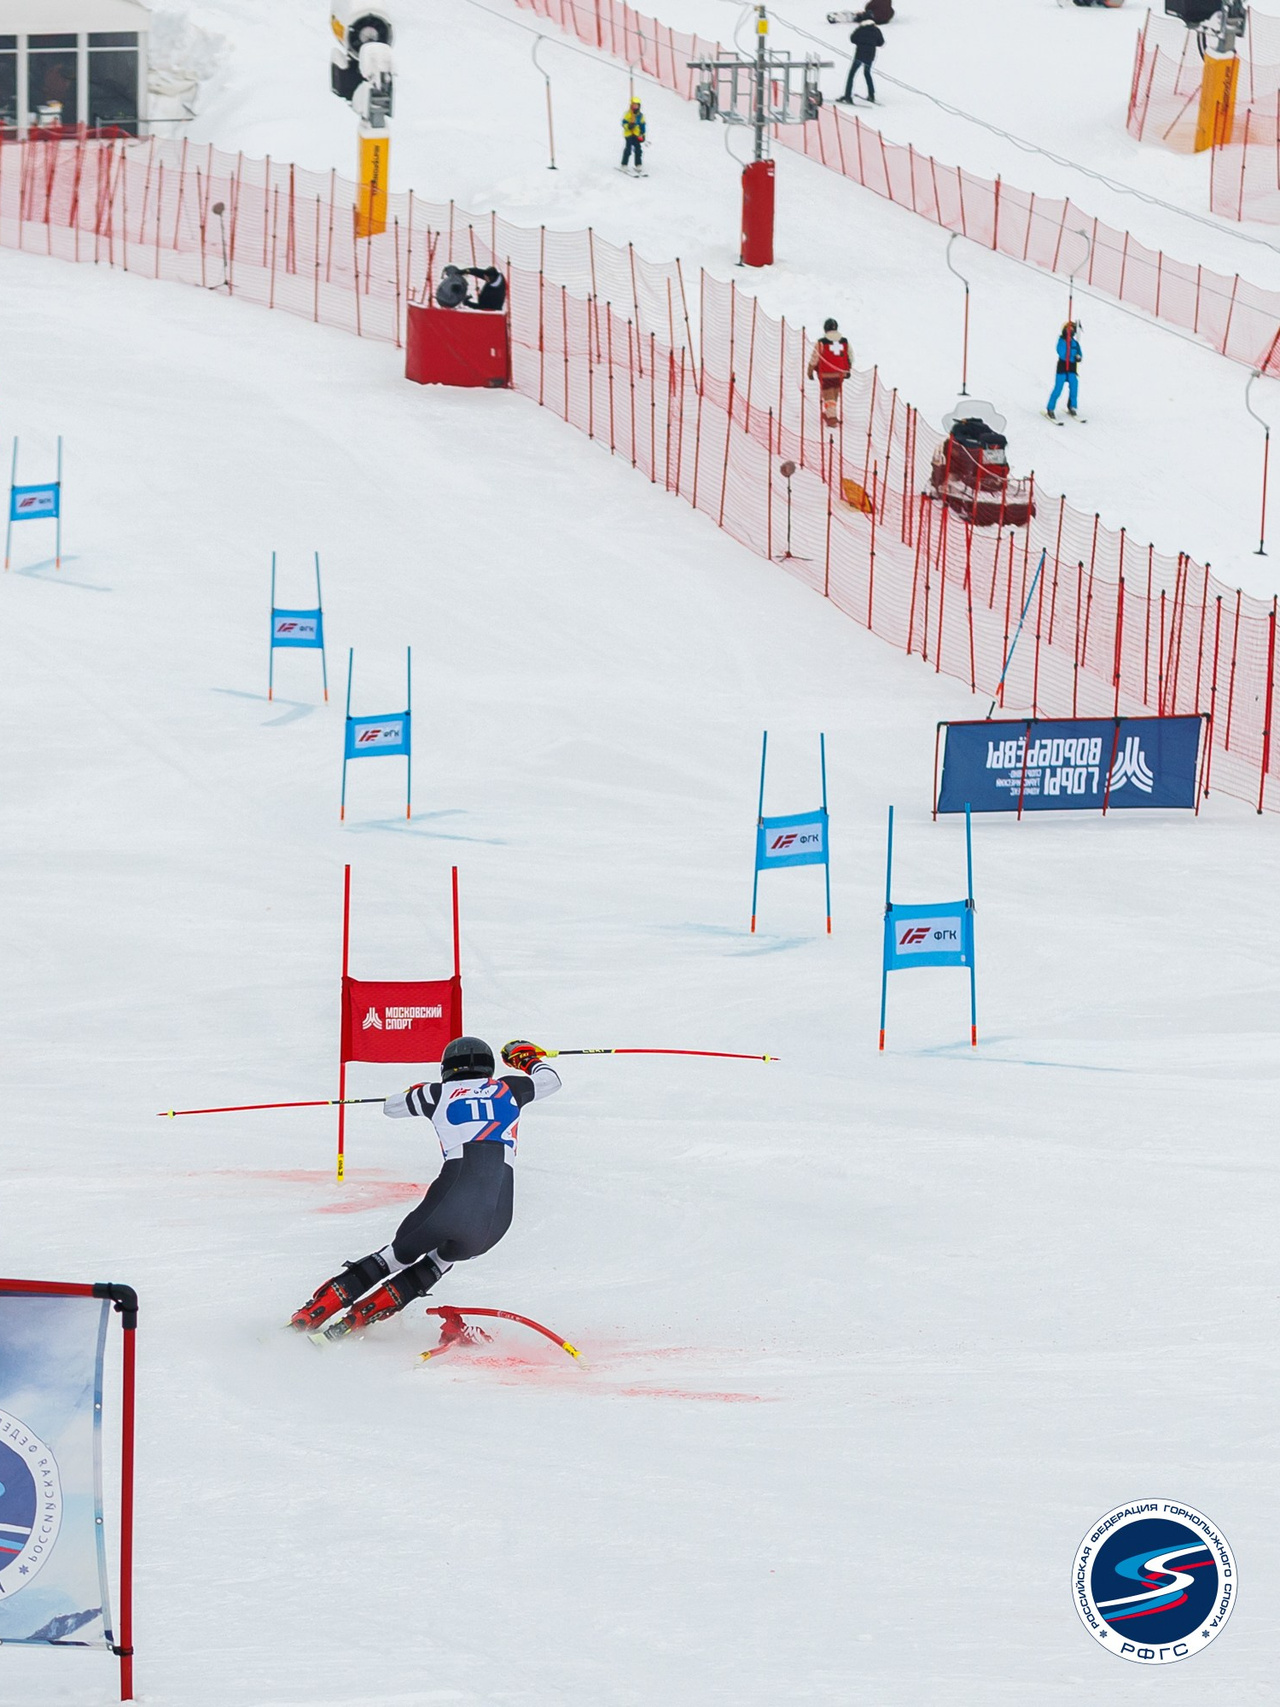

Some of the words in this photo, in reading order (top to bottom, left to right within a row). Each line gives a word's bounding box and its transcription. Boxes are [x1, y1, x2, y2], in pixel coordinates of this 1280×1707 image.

[800, 833, 819, 844] ФГК
[933, 930, 957, 940] ФГК
[385, 1004, 442, 1018] МОСКОВСКИЙ
[385, 1018, 413, 1030] СПОРТ
[465, 1099, 495, 1120] 11
